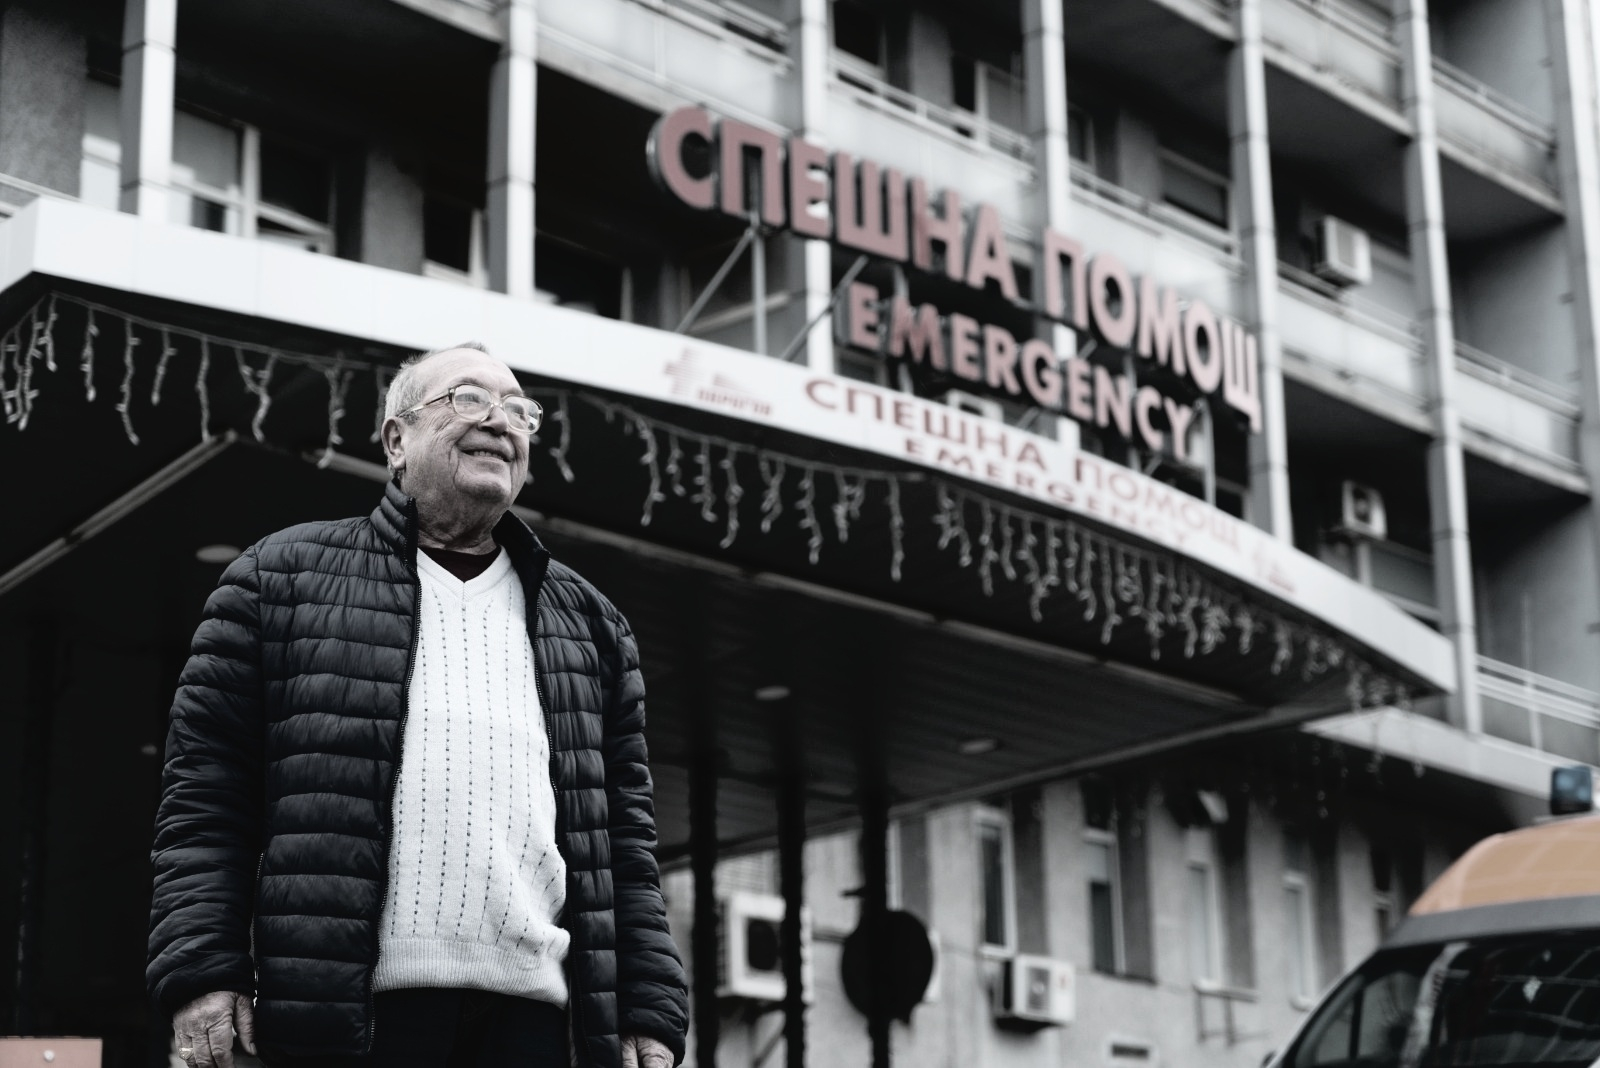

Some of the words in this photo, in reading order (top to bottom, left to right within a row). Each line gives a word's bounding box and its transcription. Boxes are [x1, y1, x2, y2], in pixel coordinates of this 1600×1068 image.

[650, 105, 1019, 299] СПЕШНА
[1044, 227, 1262, 434] ПОМОЩ
[851, 280, 1192, 461] EMERGENCY
[804, 378, 1047, 471] СПЕШНА
[1075, 457, 1240, 551] ПОМОЩ
[905, 438, 1188, 545] EMERGENCY
